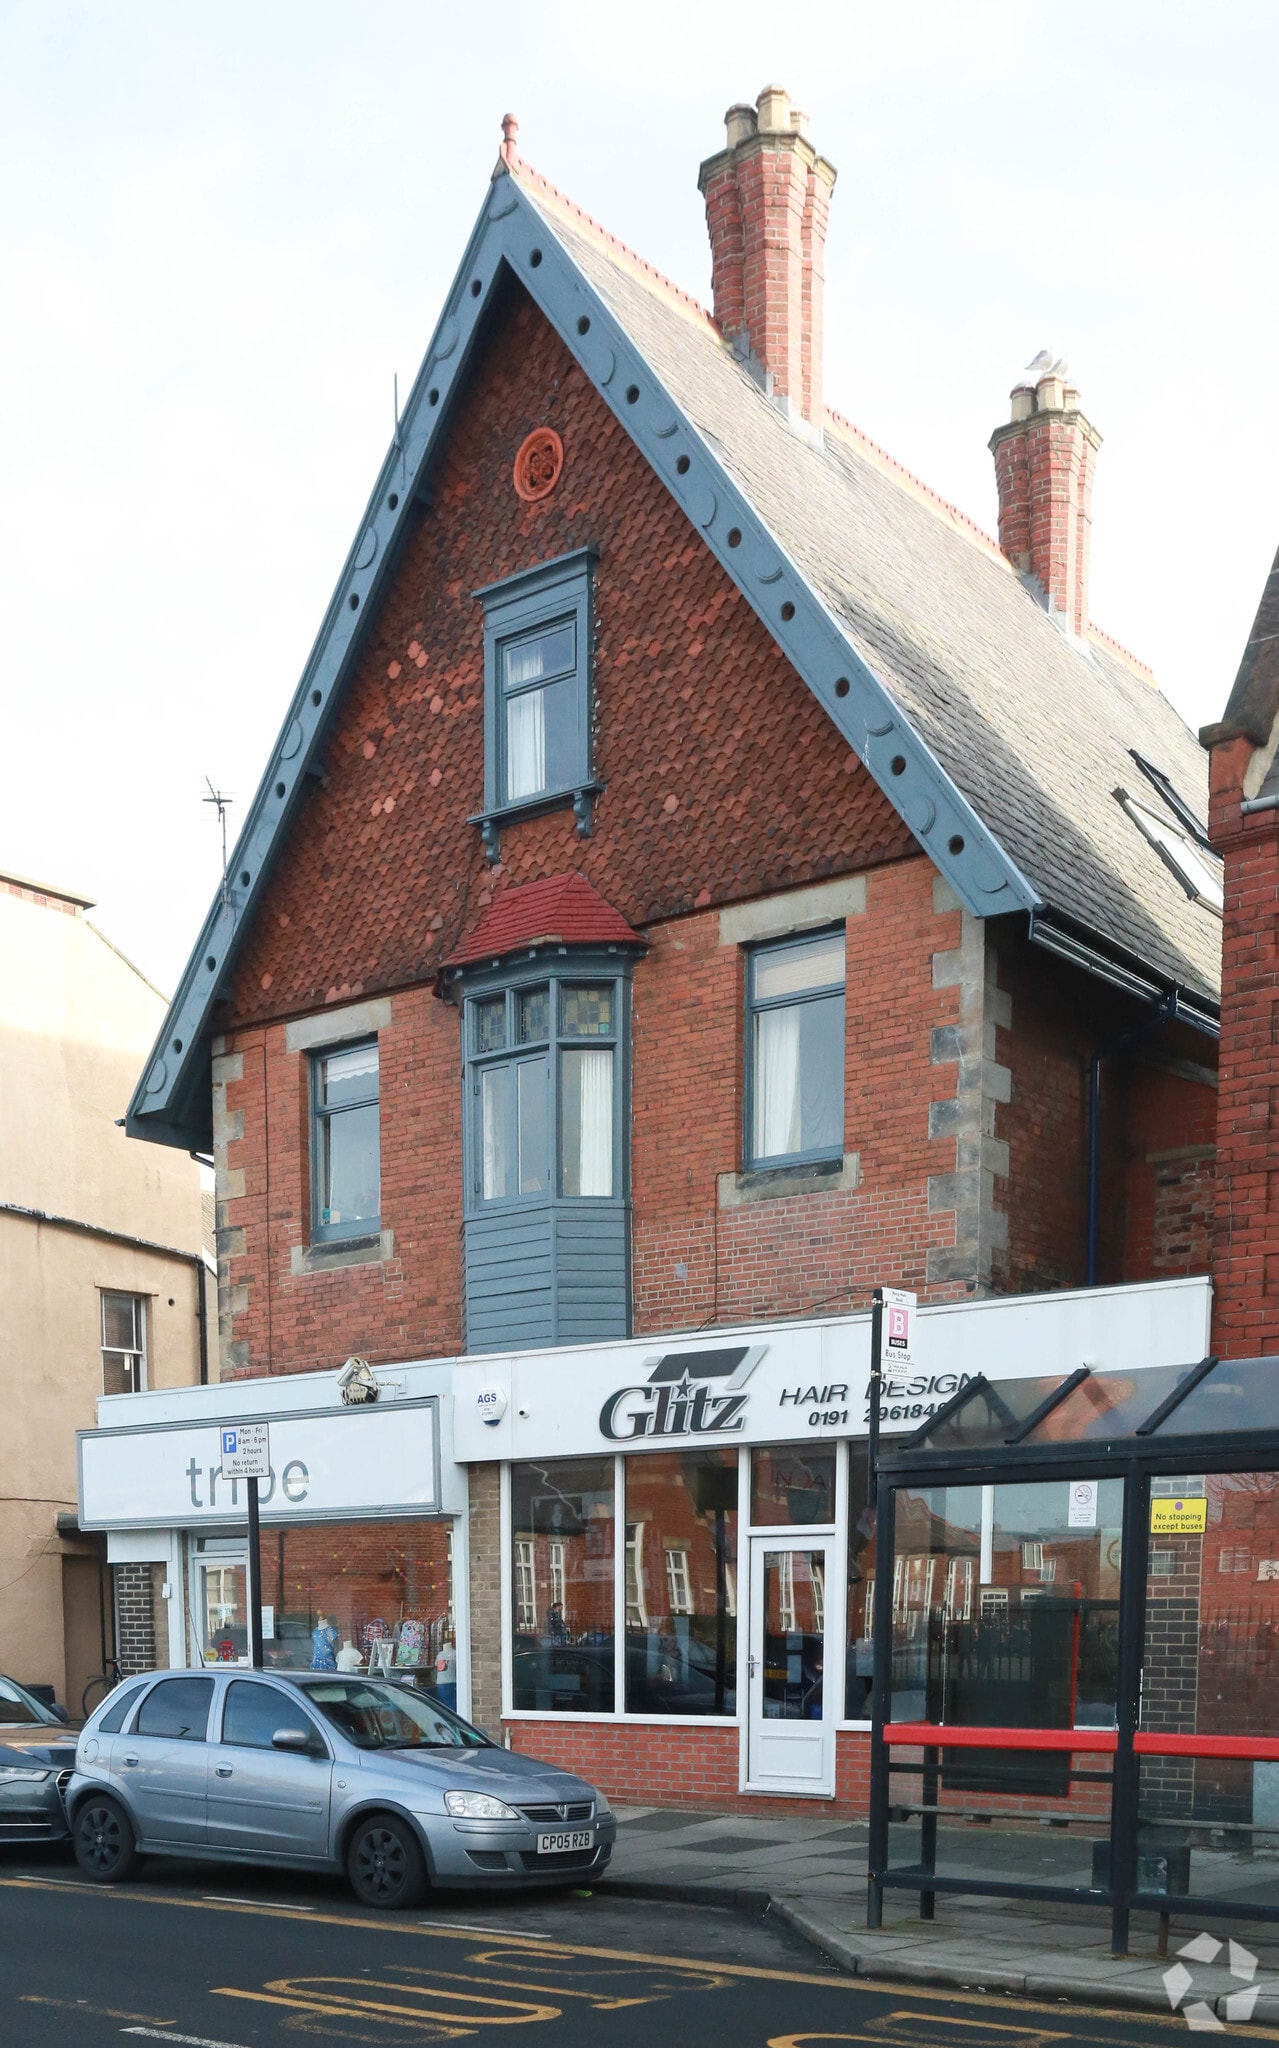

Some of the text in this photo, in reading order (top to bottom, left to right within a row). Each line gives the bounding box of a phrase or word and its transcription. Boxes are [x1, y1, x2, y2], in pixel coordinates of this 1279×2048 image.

[893, 1311, 905, 1336] B
[891, 1339, 906, 1347] BUSES
[885, 1349, 911, 1361] Bus Stop
[477, 1393, 497, 1404] AGS
[779, 1384, 849, 1406] HAIR
[599, 1380, 749, 1441] Glitz
[808, 1410, 848, 1426] 0191
[226, 1434, 235, 1452] P
[1169, 1513, 1202, 1522] stopping
[1153, 1523, 1178, 1531] except
[542, 1832, 590, 1850] CP05 RZB
